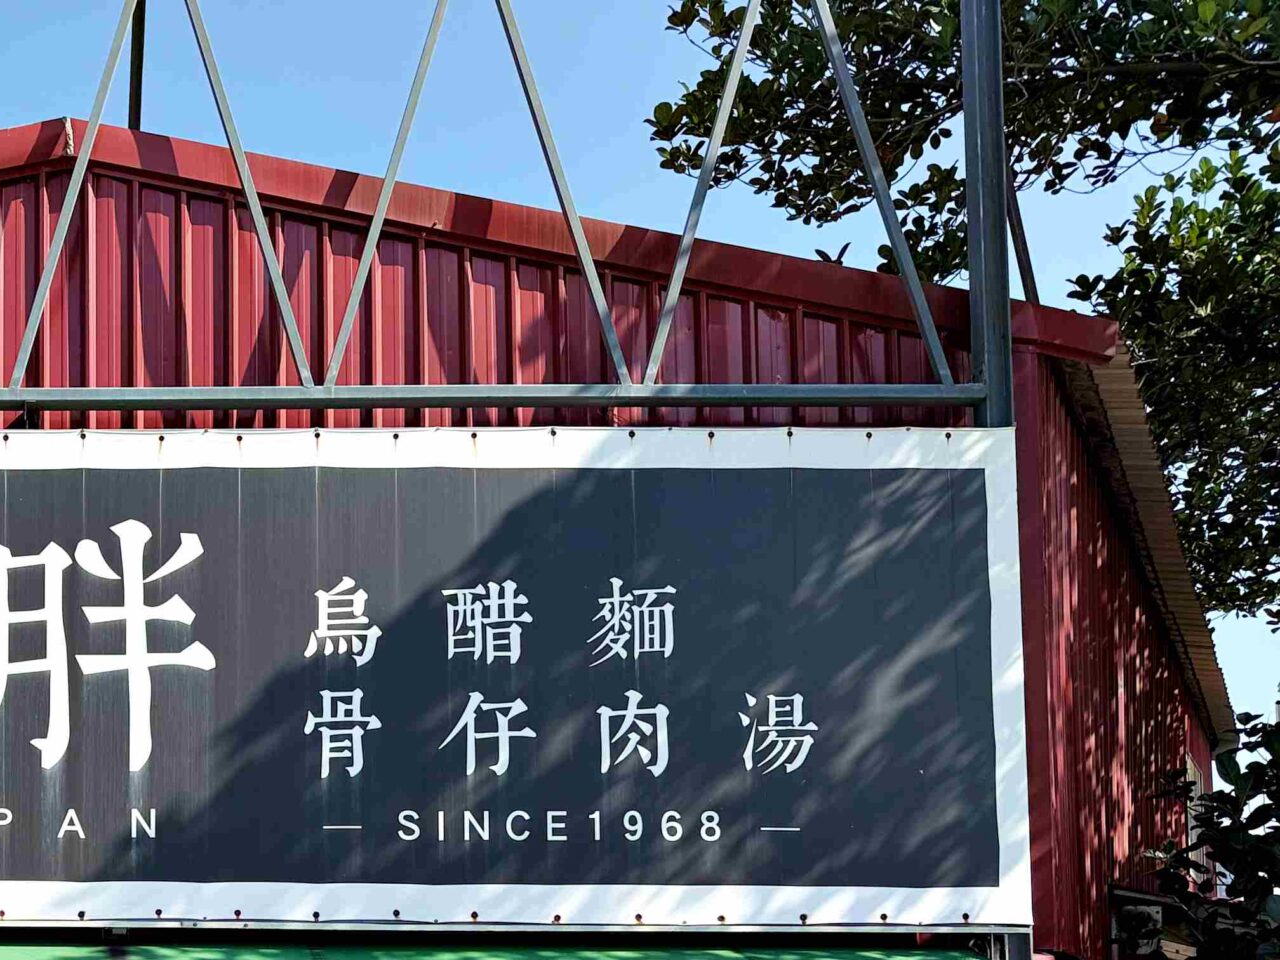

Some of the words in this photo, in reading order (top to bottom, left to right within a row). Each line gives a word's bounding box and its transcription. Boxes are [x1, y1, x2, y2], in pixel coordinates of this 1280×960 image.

[303, 576, 677, 668] 烏醋麵
[303, 687, 819, 779] 骨仔肉湯
